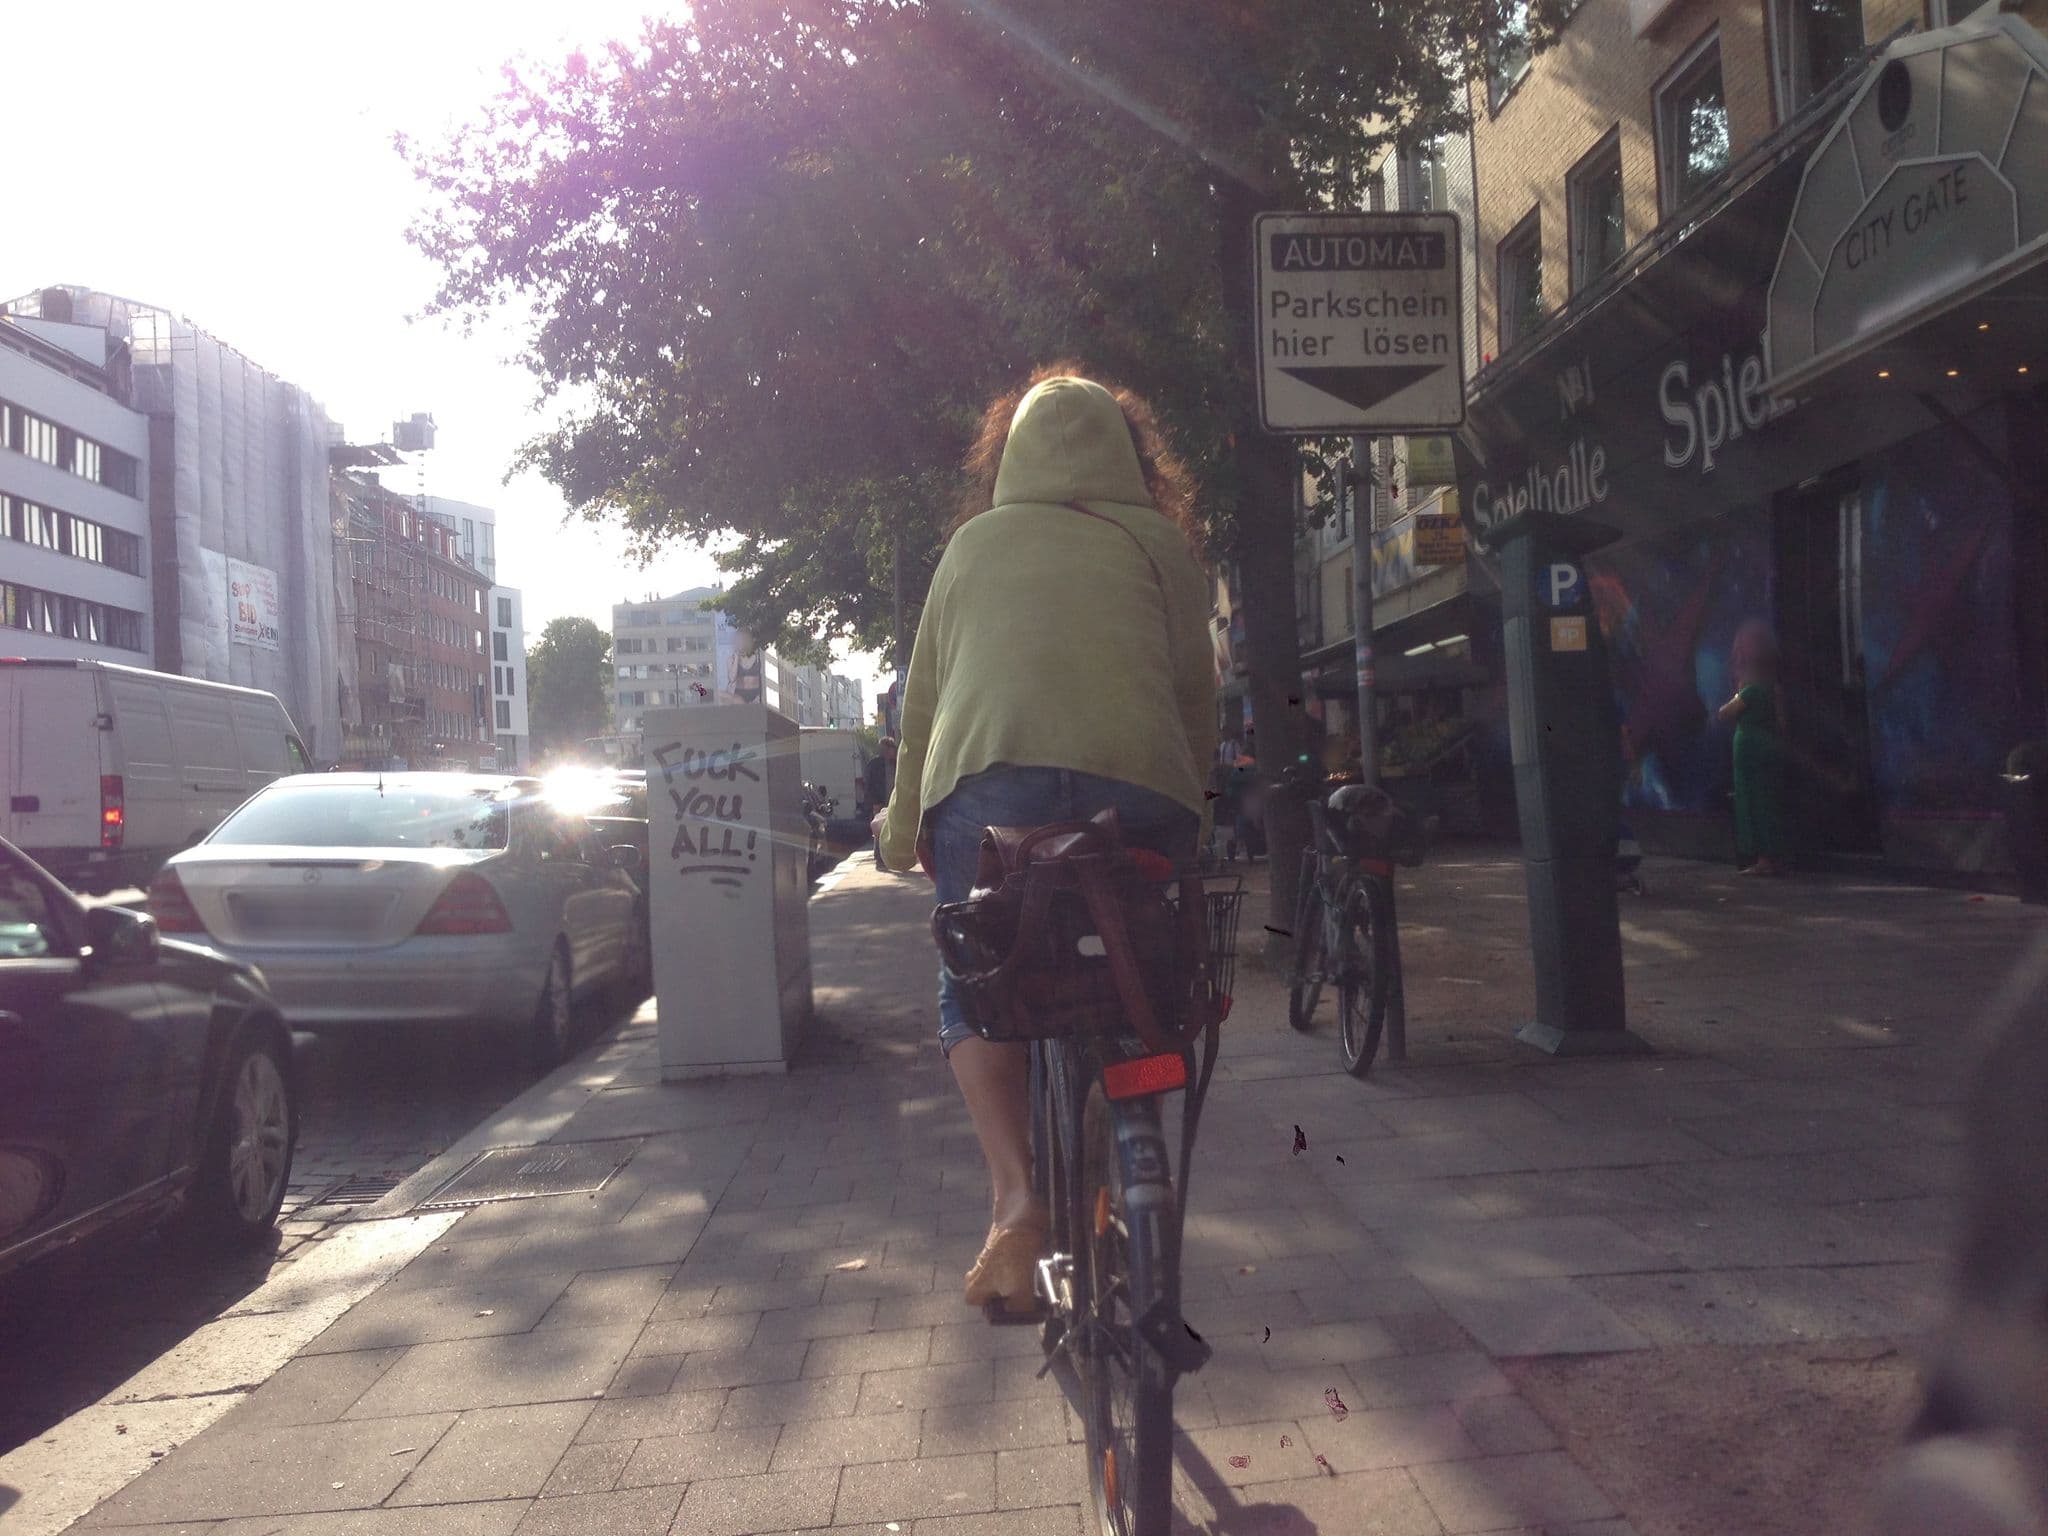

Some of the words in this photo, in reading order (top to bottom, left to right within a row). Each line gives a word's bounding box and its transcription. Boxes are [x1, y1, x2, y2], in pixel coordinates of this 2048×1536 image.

[1845, 209, 1895, 270] CITY
[1903, 165, 1968, 233] GATE
[1283, 236, 1434, 267] AUTOMAT
[1270, 289, 1448, 319] Parkschein
[1271, 328, 1335, 357] hier
[1363, 327, 1449, 356] lösen
[1550, 563, 1578, 606] P
[652, 742, 760, 784] FUCK
[668, 786, 743, 820] YOU
[671, 823, 758, 861] ALL!
